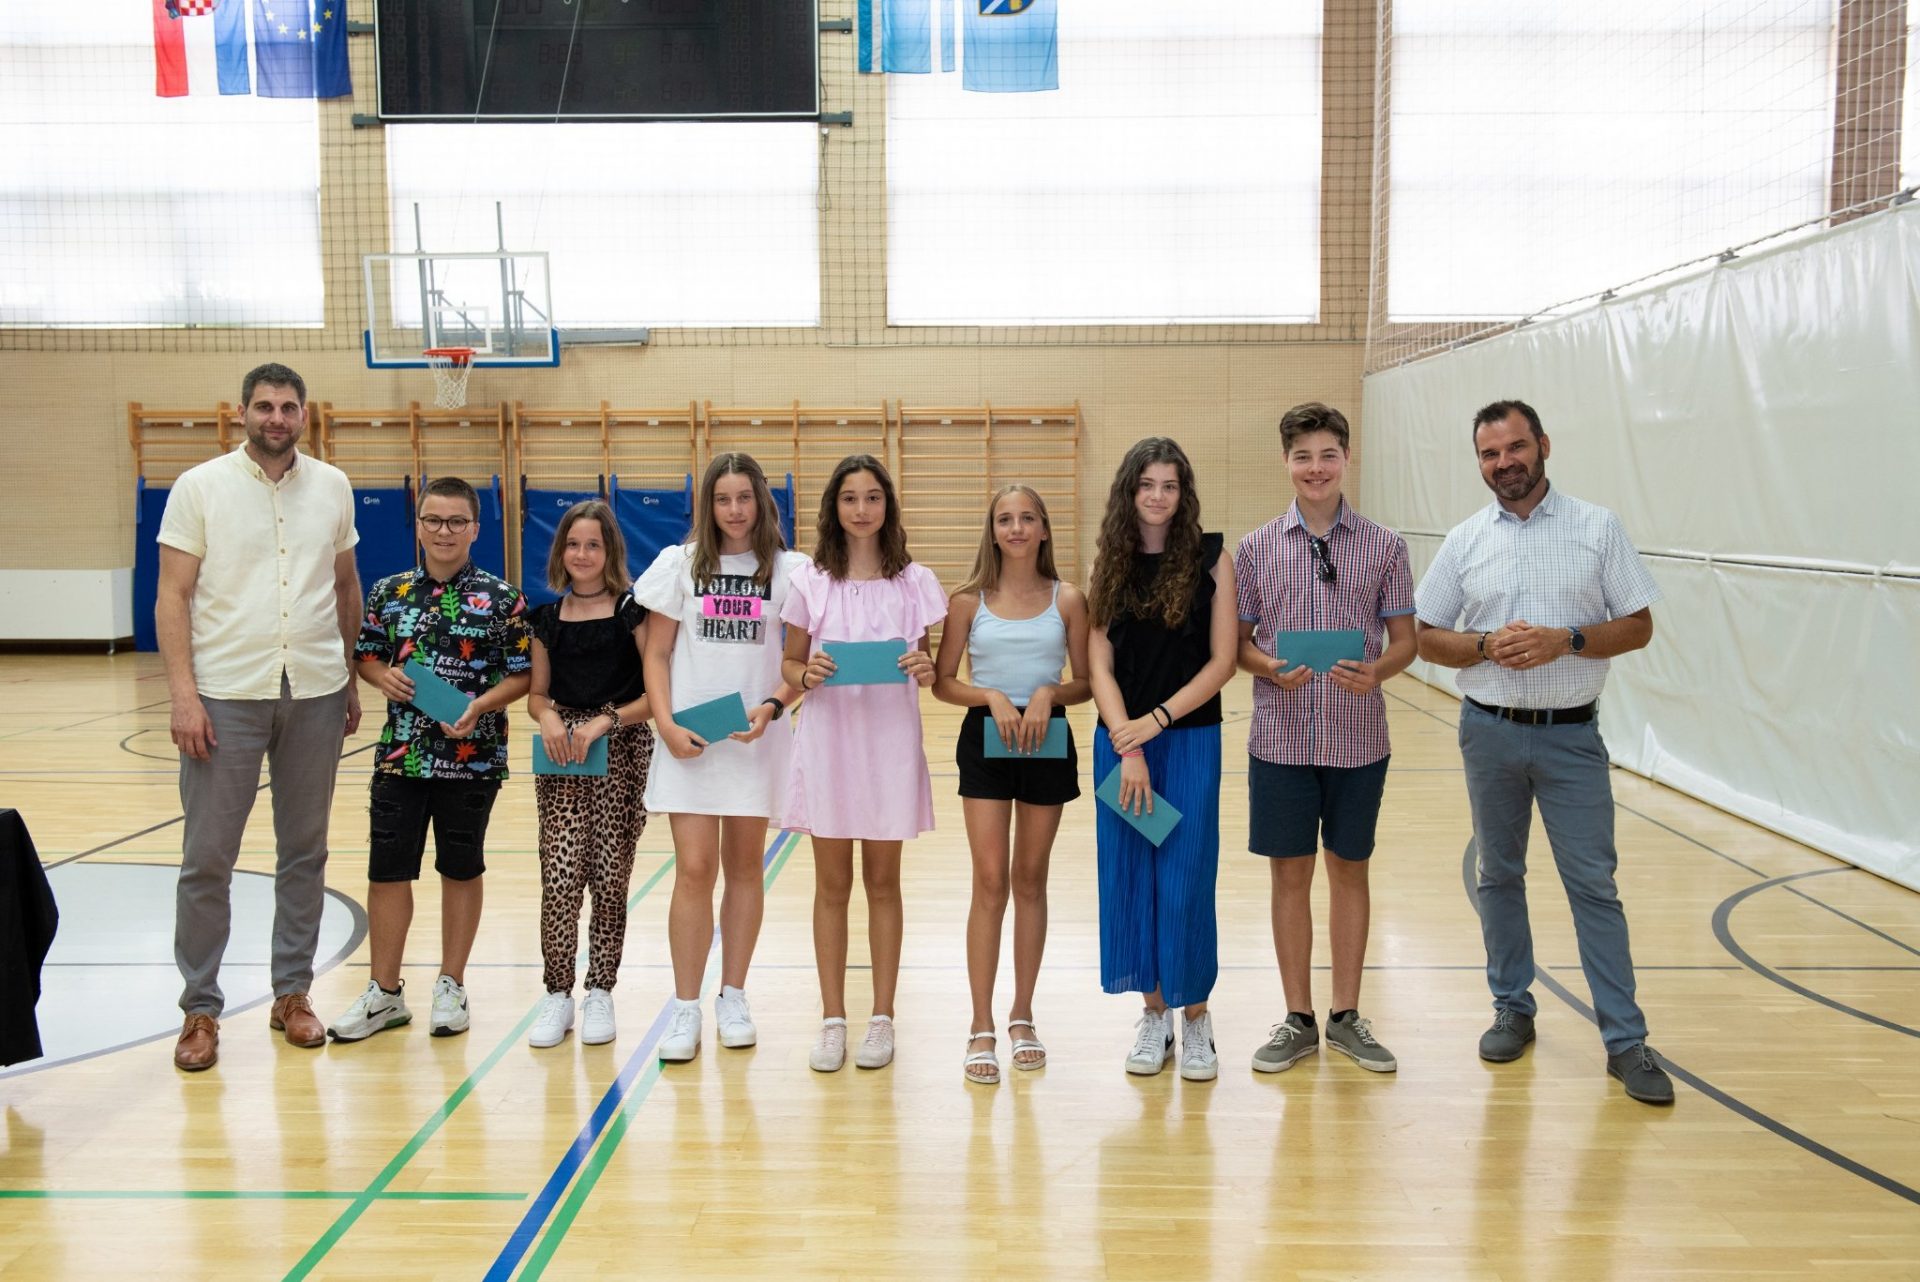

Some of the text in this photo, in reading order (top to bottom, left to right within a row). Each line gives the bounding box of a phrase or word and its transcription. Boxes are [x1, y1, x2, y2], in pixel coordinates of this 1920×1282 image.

[713, 598, 752, 615] YOUR
[448, 625, 486, 638] SKATE
[703, 618, 762, 640] HEART
[355, 641, 384, 651] KATE
[436, 655, 467, 668] KEEP
[433, 758, 465, 769] KEEP
